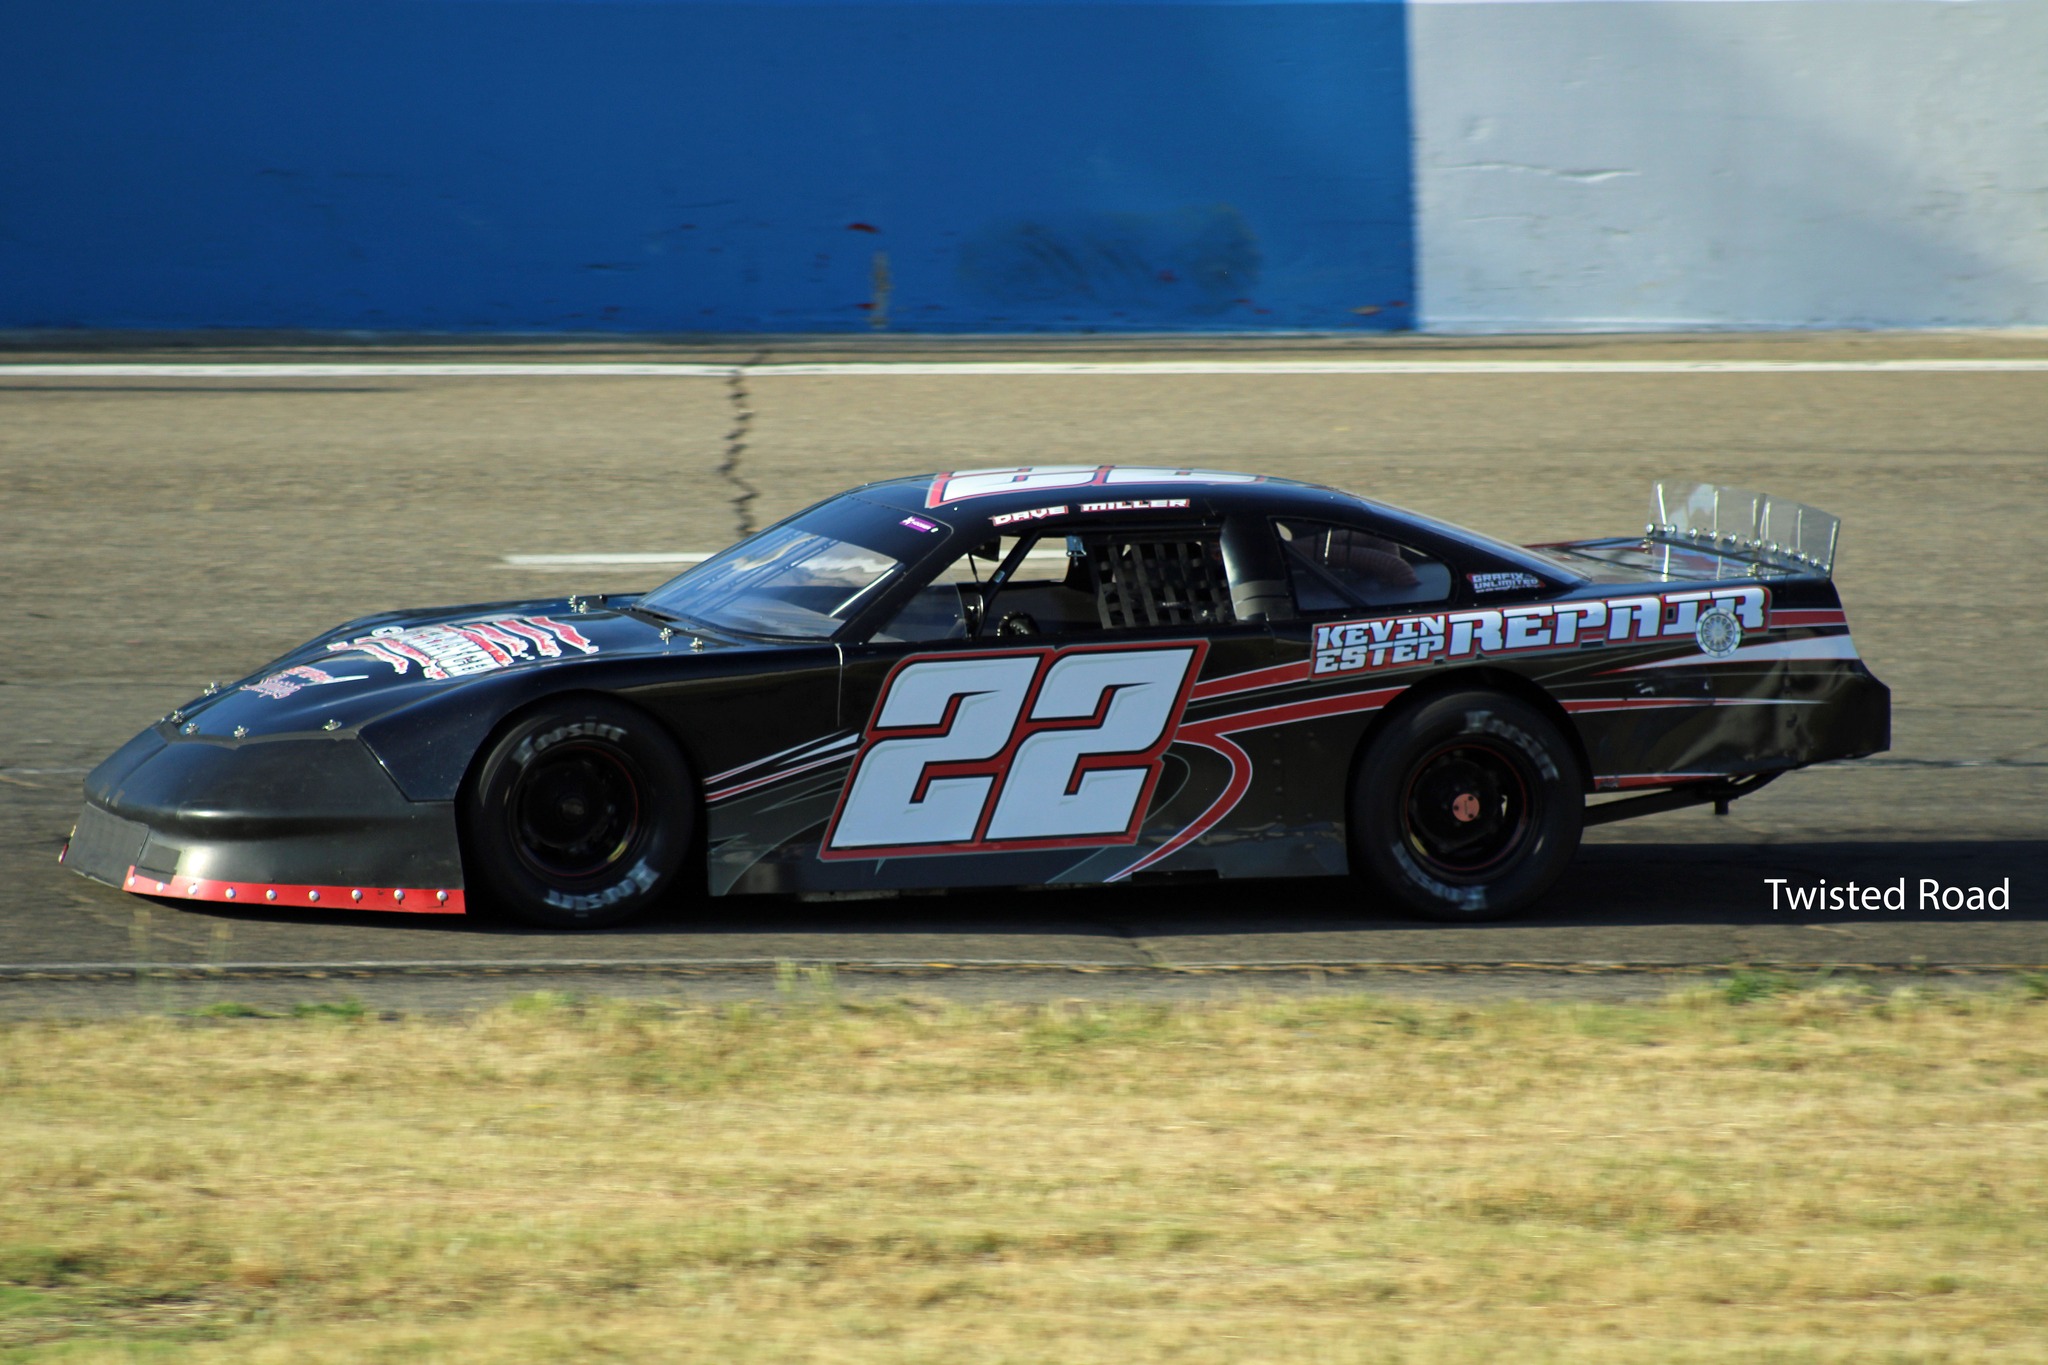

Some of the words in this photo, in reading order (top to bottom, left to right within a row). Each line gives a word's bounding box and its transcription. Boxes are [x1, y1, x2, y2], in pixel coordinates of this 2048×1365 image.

[992, 505, 1068, 526] DAVE
[1080, 499, 1190, 512] MILLER
[1471, 572, 1525, 583] GRAFIX
[1474, 579, 1539, 590] UNLIMITED
[1316, 615, 1446, 650] KEVIN
[1447, 587, 1766, 656] REPAIR
[1313, 635, 1446, 674] ESTEP
[829, 647, 1196, 848] 22
